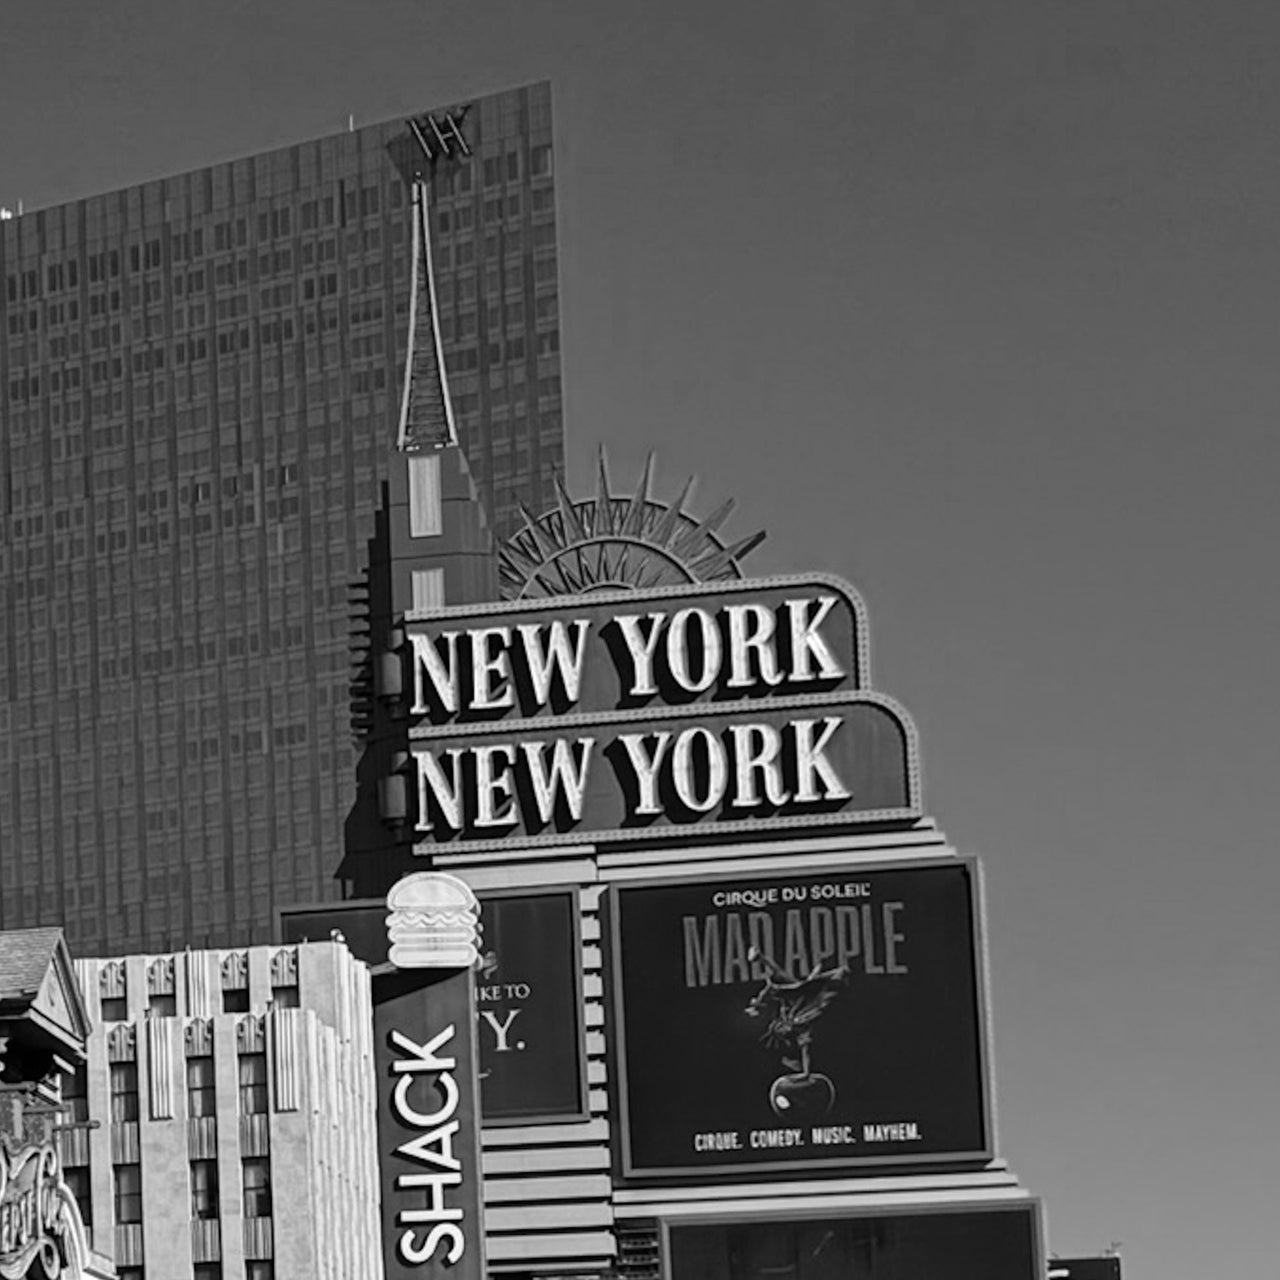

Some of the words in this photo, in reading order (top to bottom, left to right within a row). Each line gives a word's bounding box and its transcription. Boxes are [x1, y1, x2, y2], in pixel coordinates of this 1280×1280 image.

[408, 618, 590, 717] NEW
[614, 596, 848, 699] YORK
[412, 738, 595, 834] NEW
[618, 716, 852, 818] YORK
[712, 889, 778, 907] CIRQUE
[781, 886, 807, 901] DU
[810, 882, 871, 899] SOLEIL
[682, 911, 775, 987] MAD
[783, 901, 909, 978] APPLE
[503, 983, 531, 999] TO
[391, 1023, 466, 1265] SHACK
[694, 1132, 743, 1151] CIRQUE.
[749, 1129, 805, 1148] COMEDY.
[811, 1126, 856, 1144] MUSIC.
[863, 1123, 921, 1142] MAYHEM.
